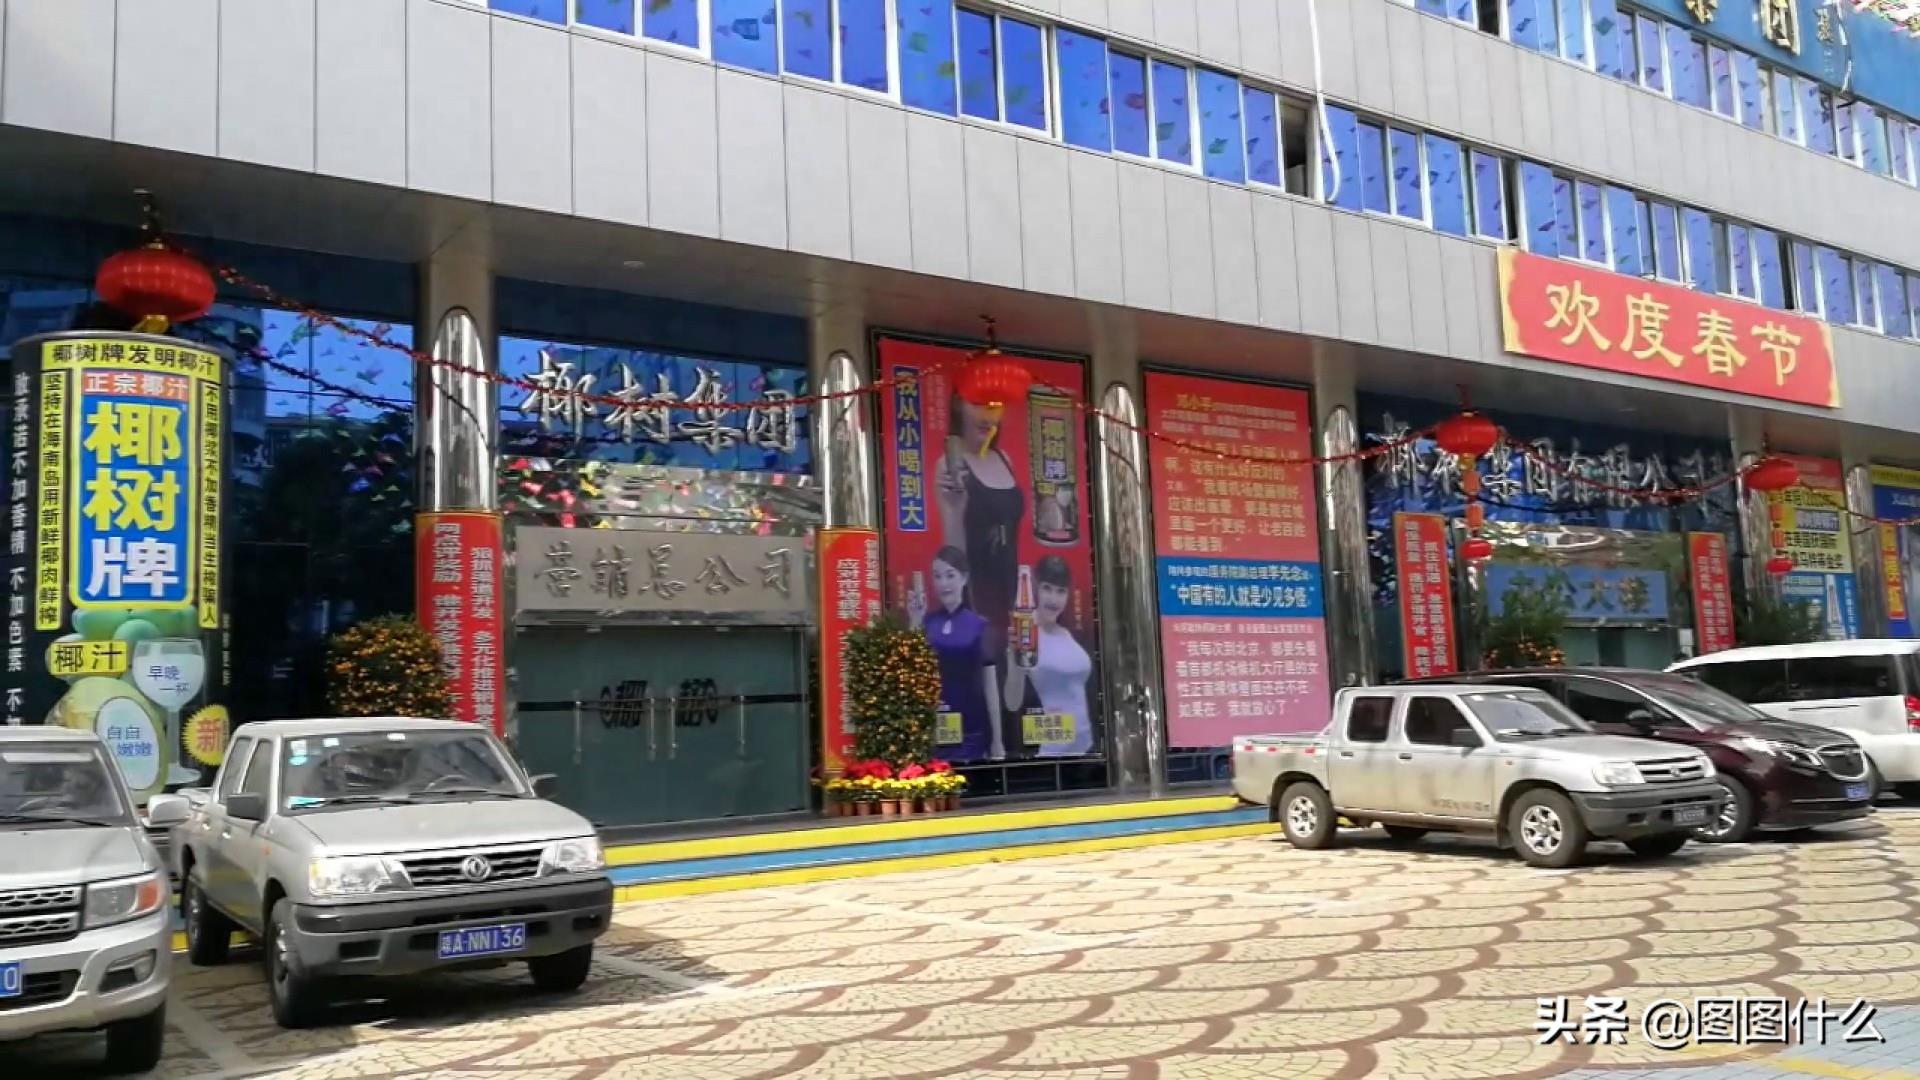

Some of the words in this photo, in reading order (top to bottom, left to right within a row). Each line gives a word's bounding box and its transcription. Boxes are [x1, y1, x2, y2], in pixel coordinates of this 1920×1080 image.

[1543, 279, 1805, 387] 欢度春节
[53, 344, 214, 376] 椰树牌发明椰汁
[85, 373, 188, 400] 正宗椰汁
[520, 350, 797, 452] 椰树集团
[82, 402, 183, 597] 椰树牌
[534, 541, 793, 600] 营销总公司
[55, 643, 122, 673] 椰汁
[197, 718, 227, 754] 新
